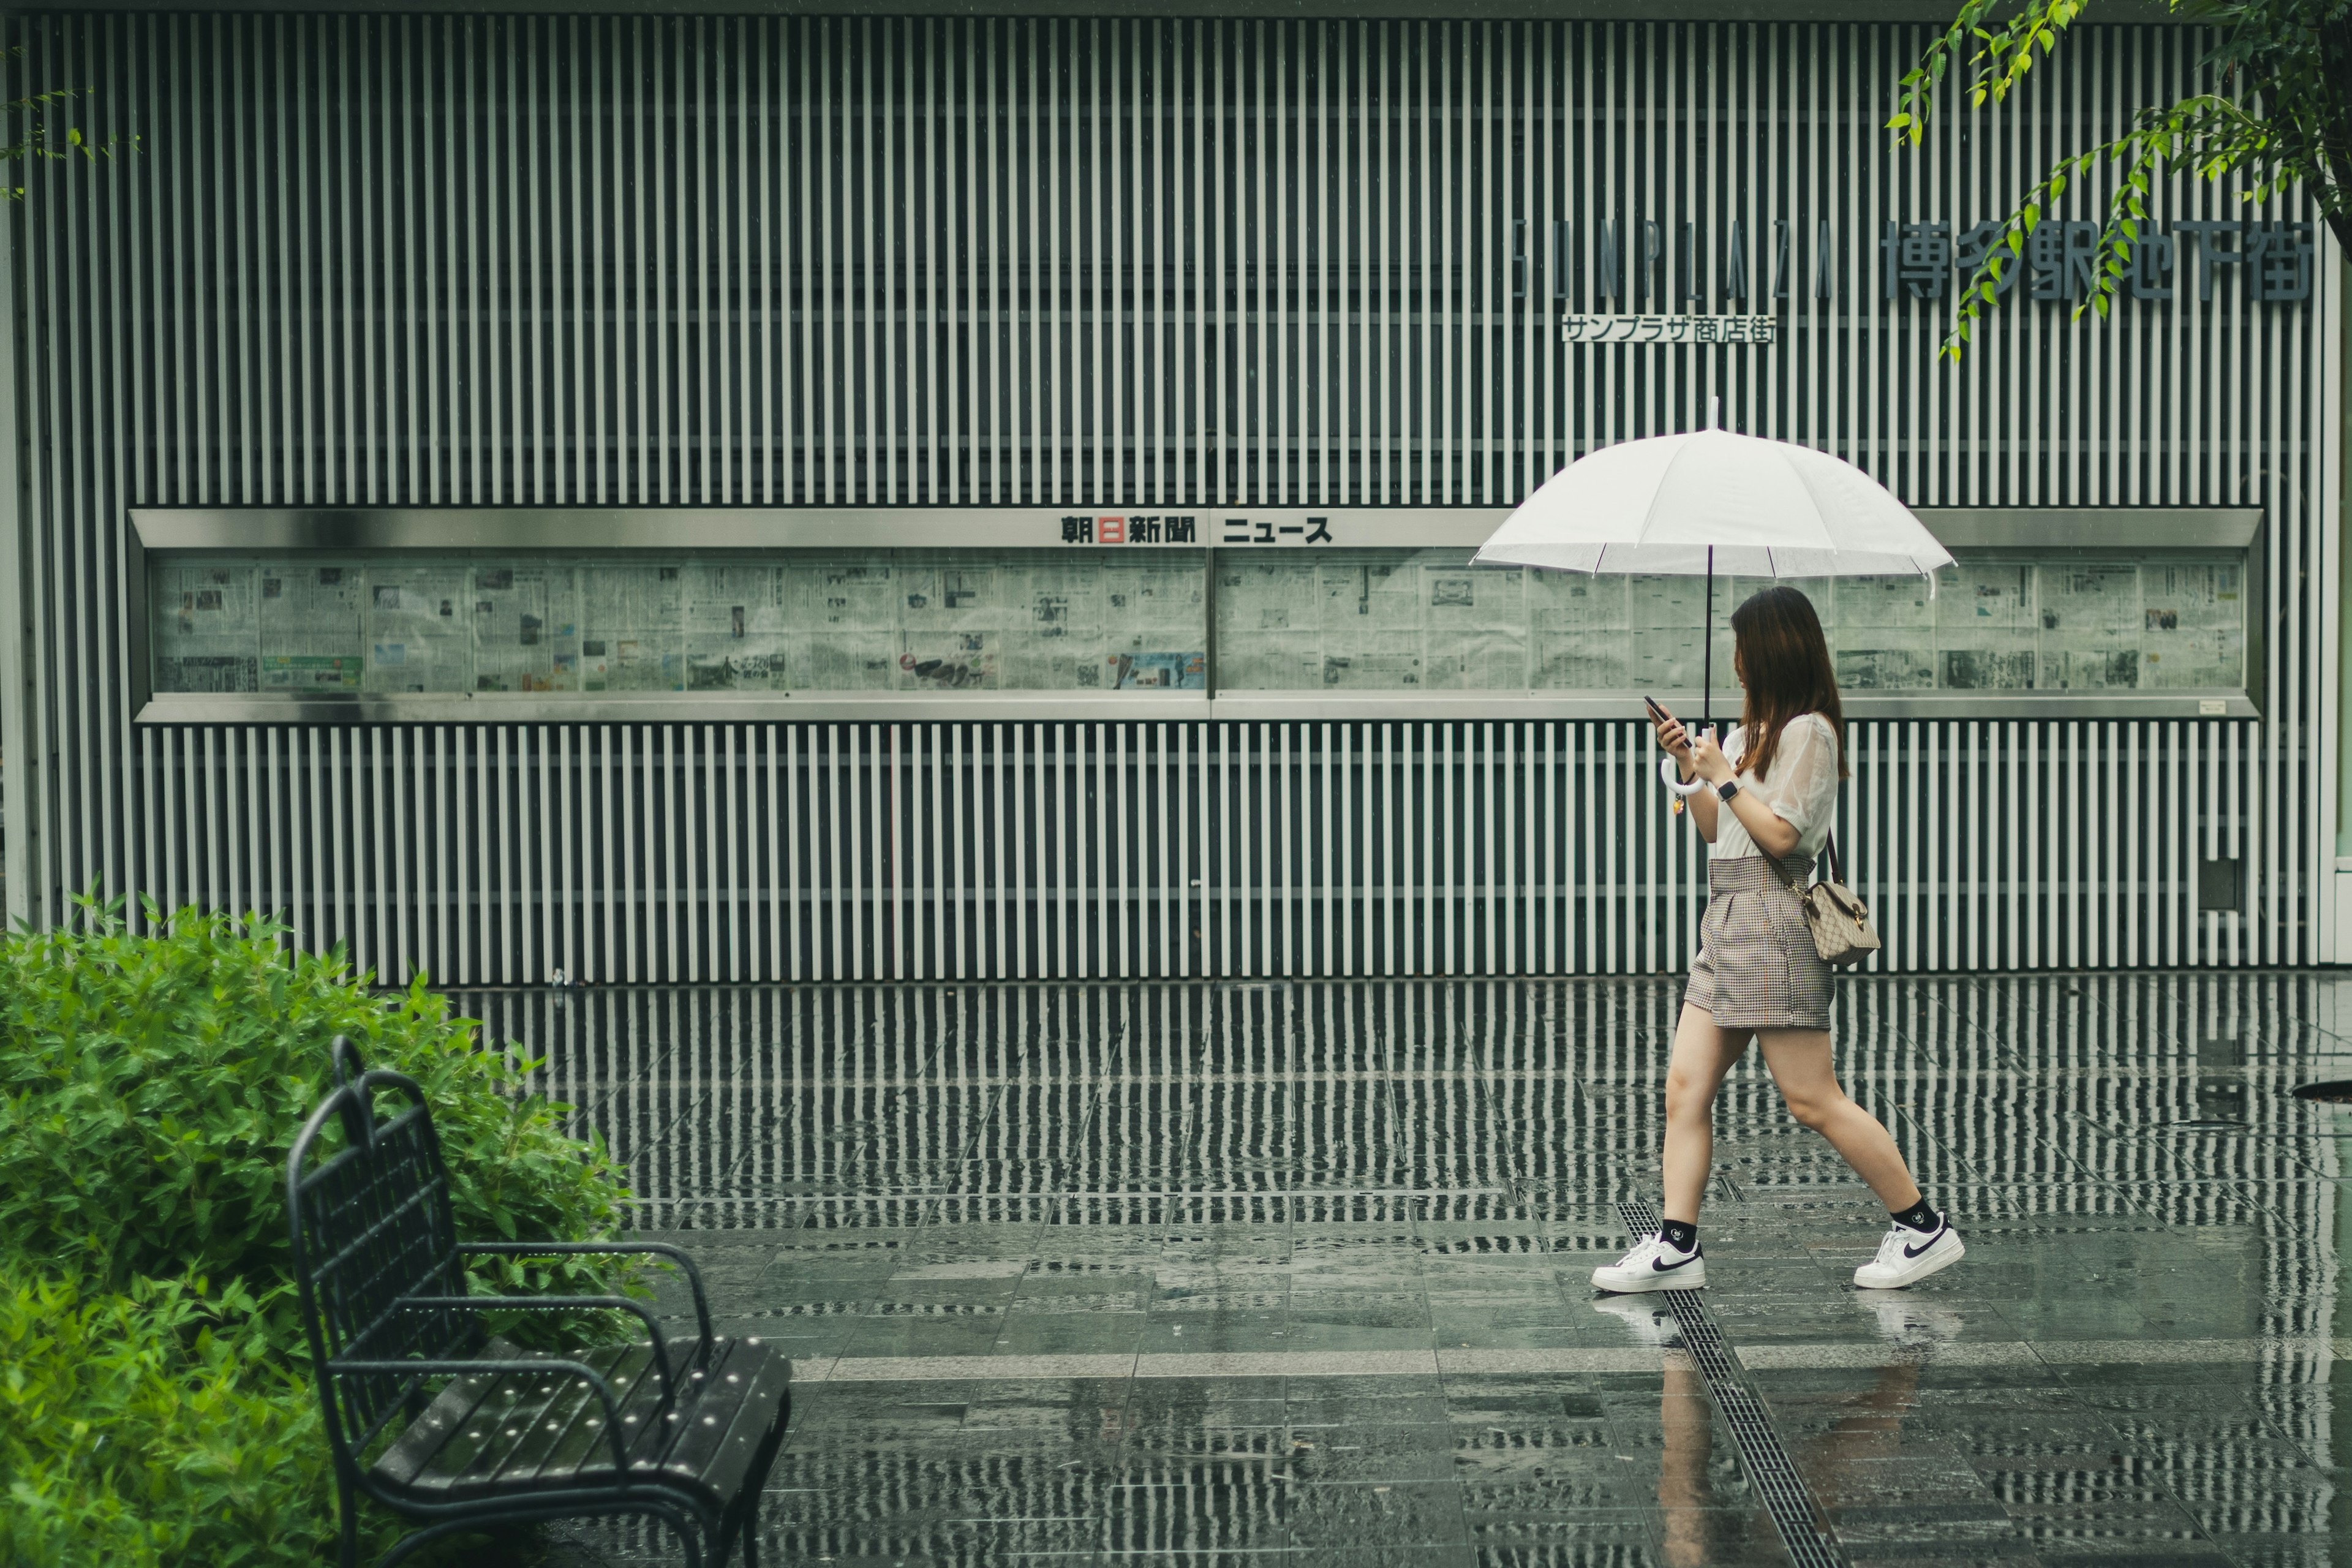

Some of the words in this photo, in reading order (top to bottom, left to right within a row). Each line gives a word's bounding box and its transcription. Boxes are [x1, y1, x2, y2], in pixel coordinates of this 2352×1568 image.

[1512, 219, 1832, 300] SUNPLAZA
[1880, 219, 2313, 301] 博多駅地下街
[1562, 315, 1775, 344] サンプラザ商店街
[1061, 516, 1196, 544] 朝日新聞
[1223, 517, 1333, 545] ニュース
